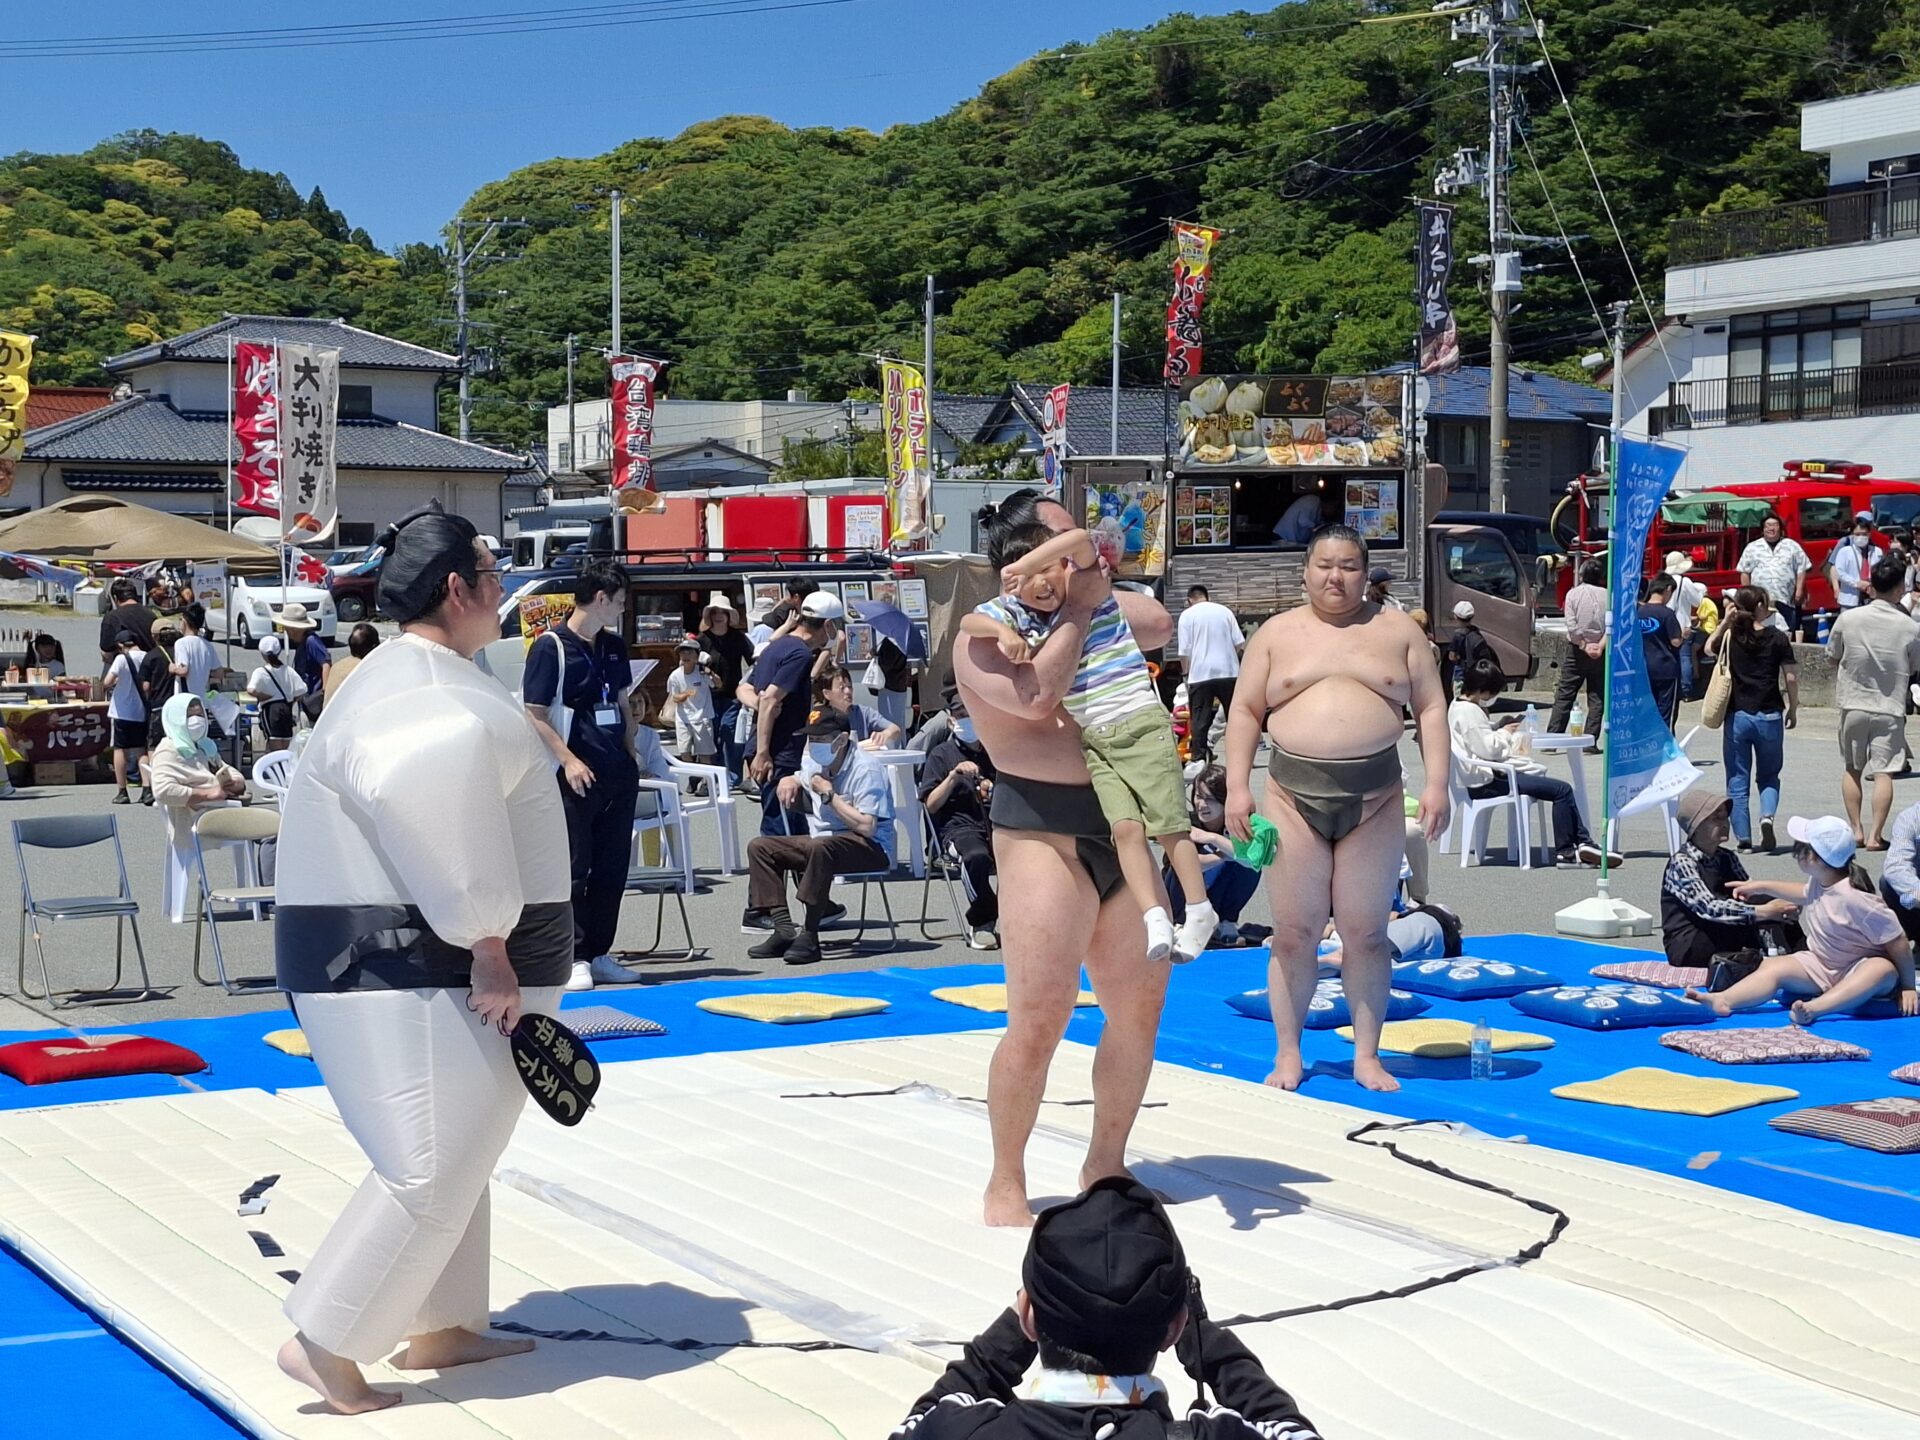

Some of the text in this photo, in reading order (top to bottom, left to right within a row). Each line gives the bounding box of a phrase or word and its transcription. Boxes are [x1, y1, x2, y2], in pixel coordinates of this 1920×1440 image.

[291, 356, 324, 504] 大判焼き
[888, 368, 908, 489] ハリケーン
[907, 387, 927, 466] ポテト
[47, 724, 106, 750] バナナ
[518, 1049, 560, 1099] 天下
[535, 1017, 575, 1067] 泰平
